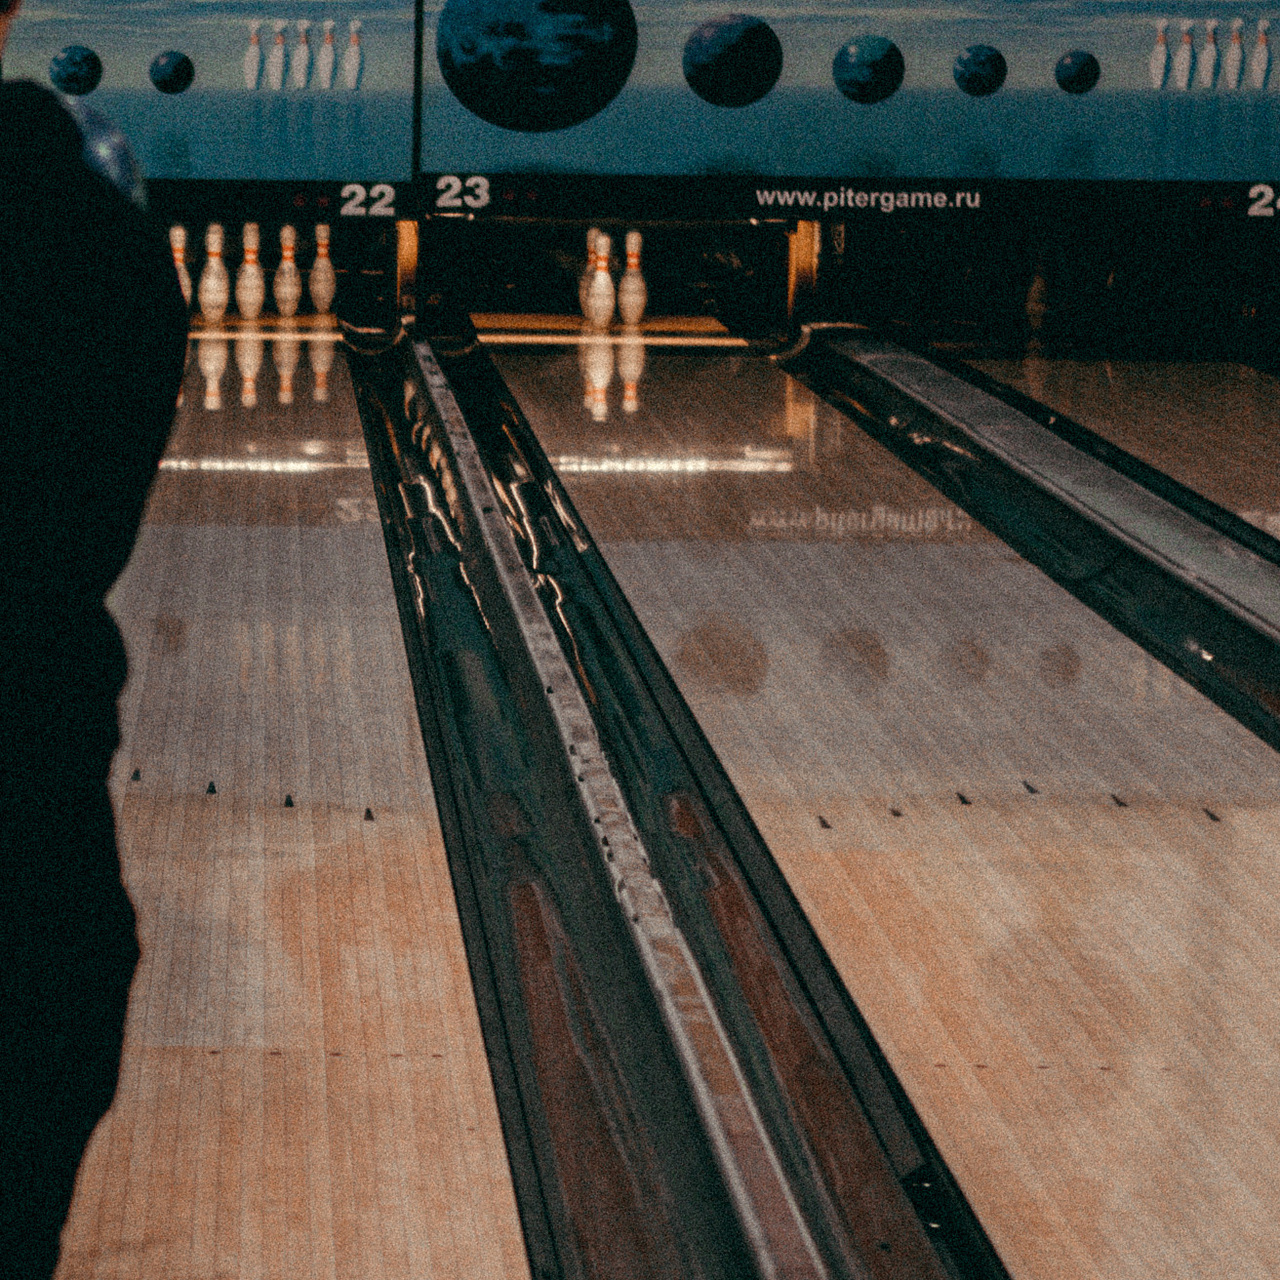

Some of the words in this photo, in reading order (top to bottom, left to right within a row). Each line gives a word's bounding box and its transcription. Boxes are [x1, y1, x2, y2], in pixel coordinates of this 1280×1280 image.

[339, 182, 396, 217] 22
[435, 173, 491, 209] 23
[754, 186, 982, 214] www.pitergame.ru
[1247, 182, 1280, 217] 2
